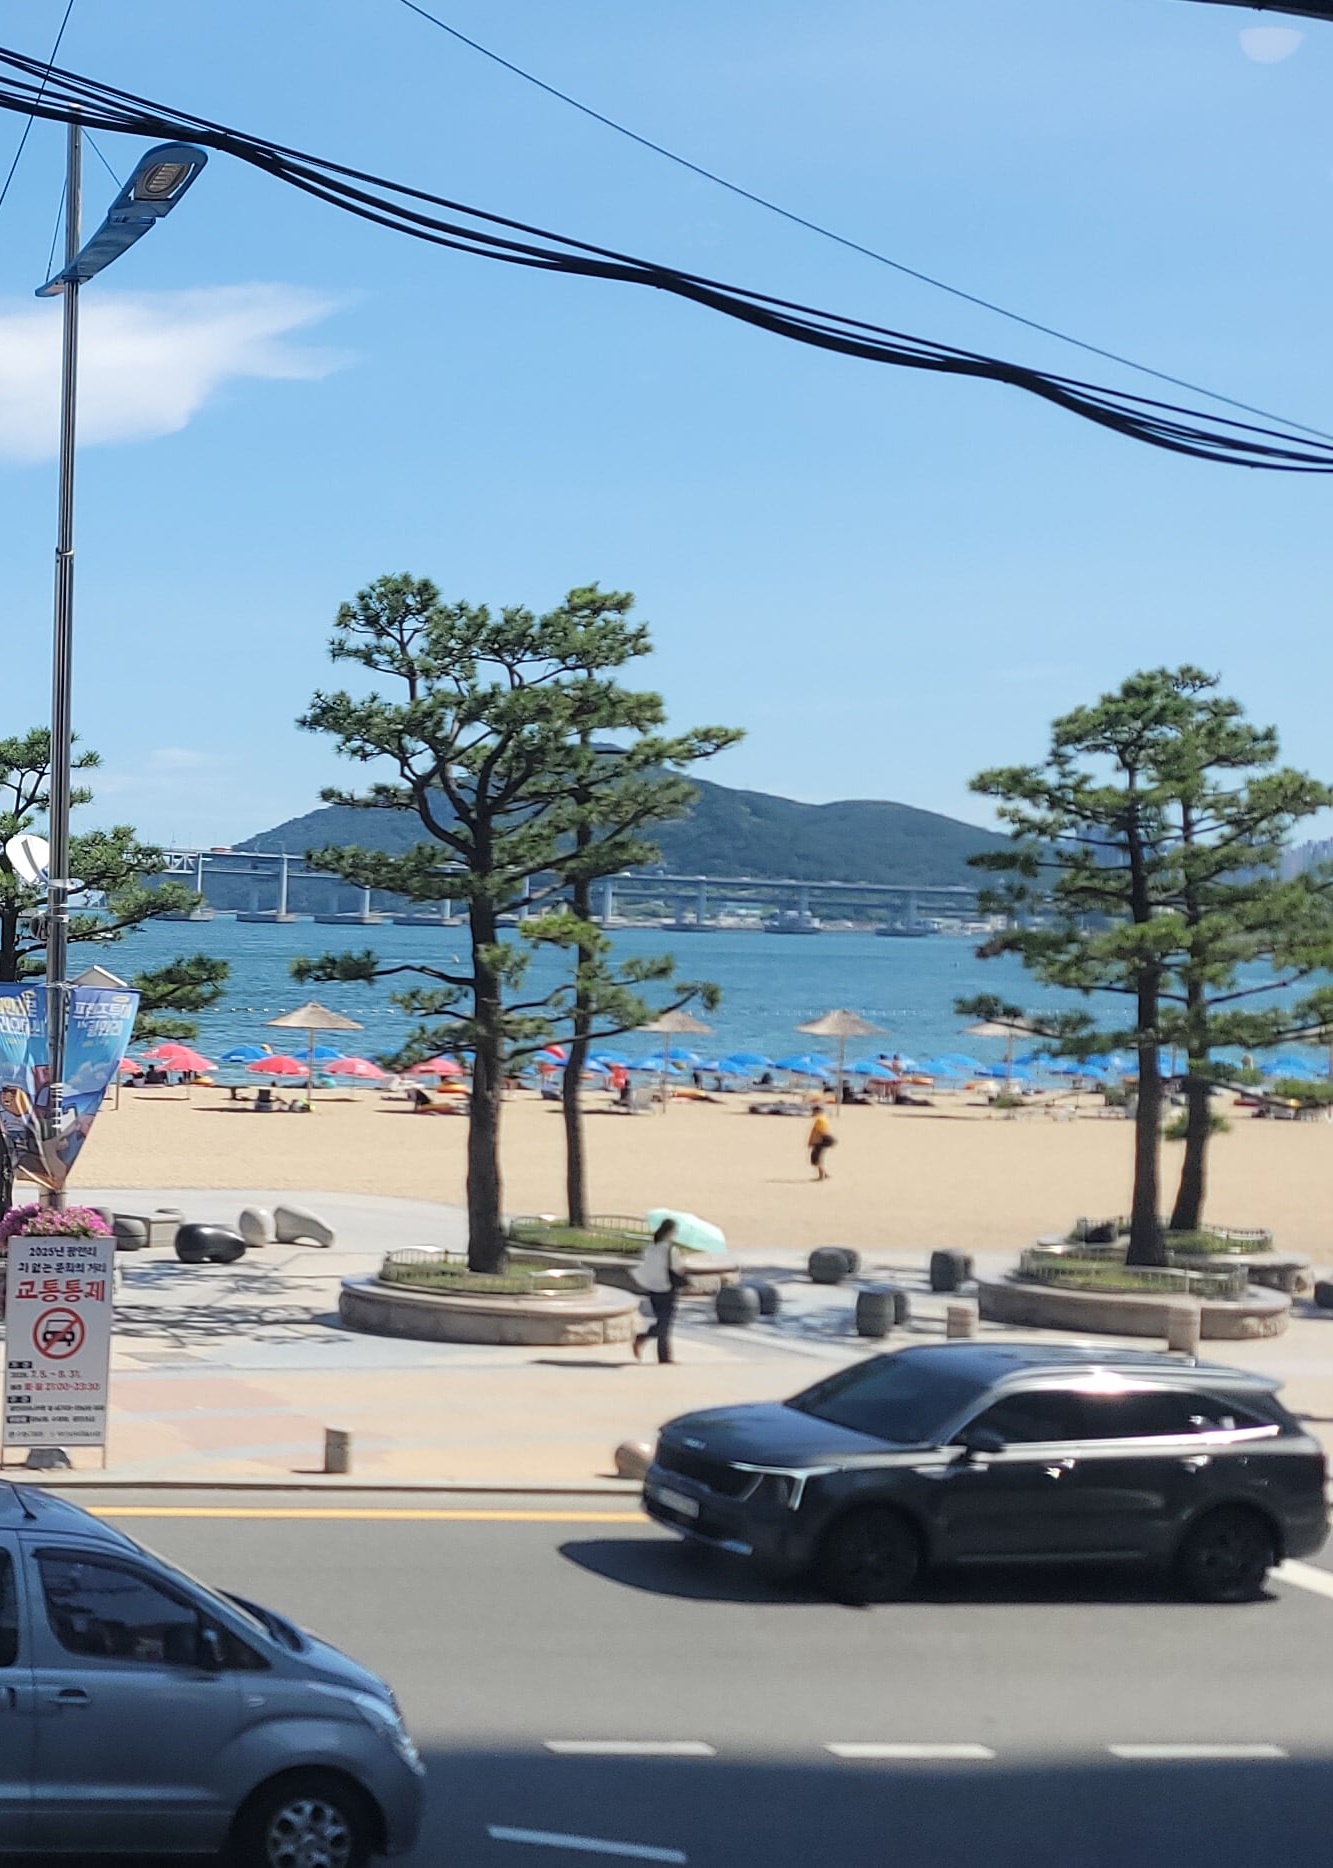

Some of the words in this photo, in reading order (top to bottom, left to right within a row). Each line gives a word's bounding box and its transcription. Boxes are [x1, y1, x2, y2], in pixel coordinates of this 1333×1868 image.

[29, 1246, 65, 1257] 2025년
[66, 1246, 97, 1258] 광안리
[31, 1263, 53, 1273] 없는
[53, 1262, 85, 1273] 문화의
[86, 1262, 107, 1274] 거리
[15, 1278, 105, 1303] 교통통제
